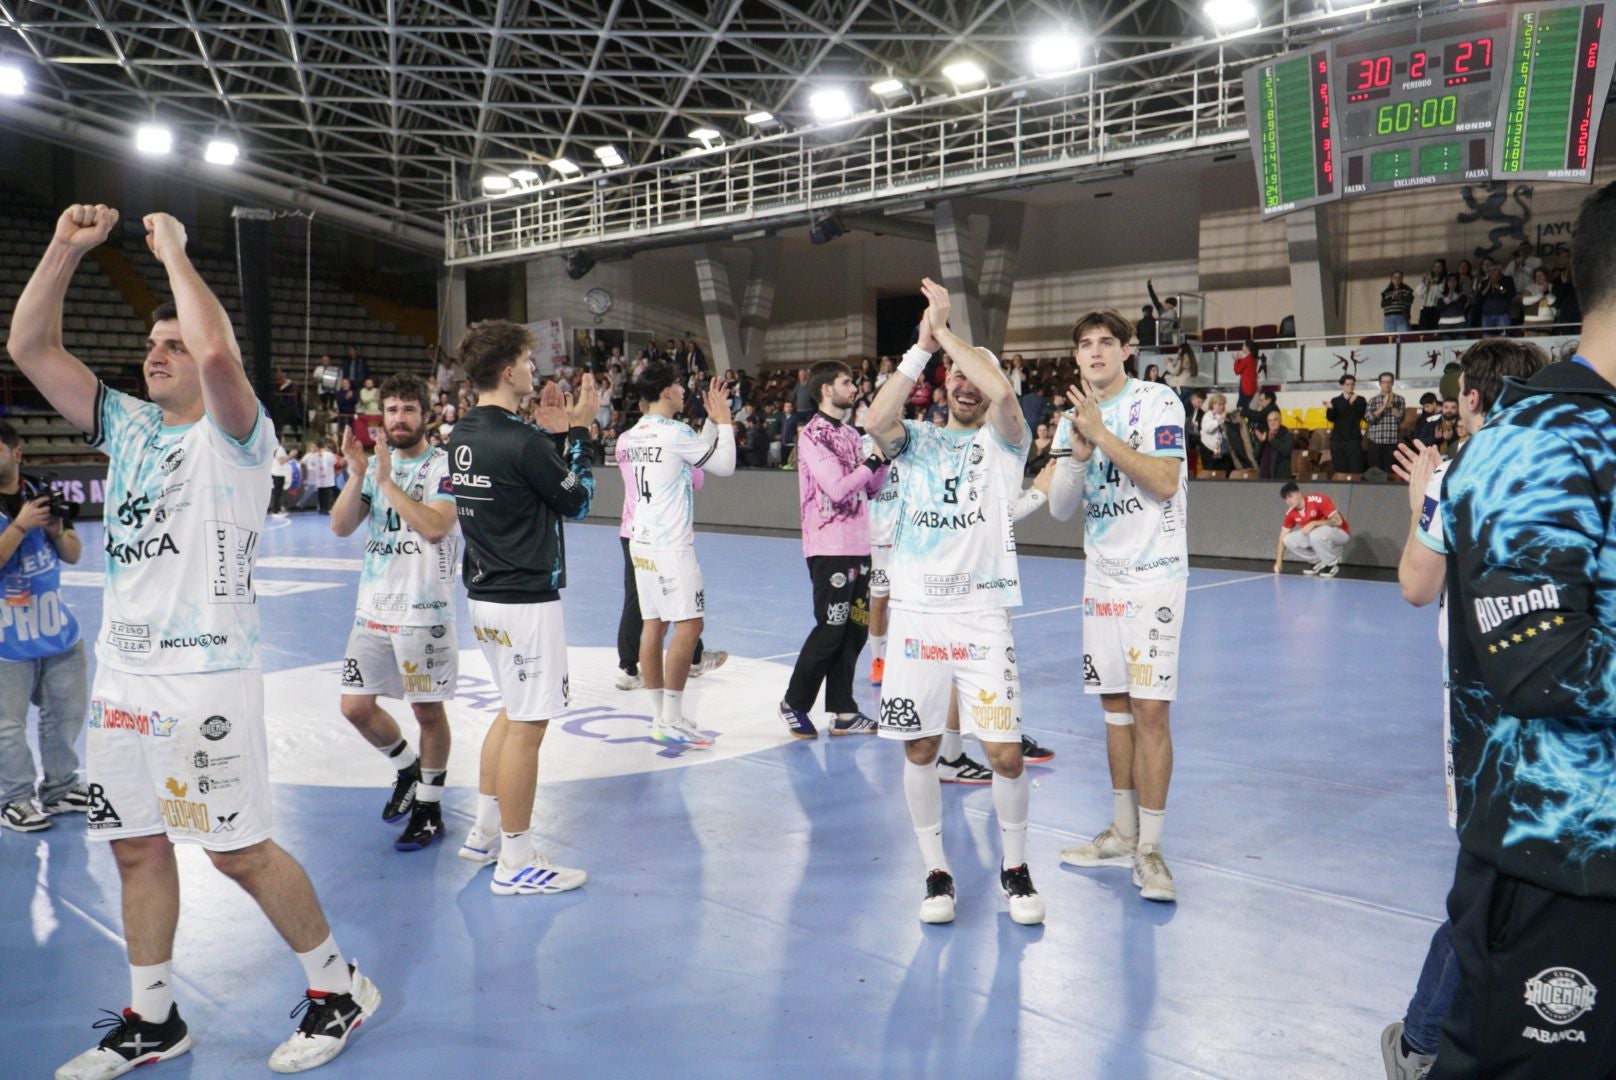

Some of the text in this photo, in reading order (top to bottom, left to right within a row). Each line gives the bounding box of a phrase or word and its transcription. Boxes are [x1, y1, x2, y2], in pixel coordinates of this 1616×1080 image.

[1524, 37, 1532, 49] 3
[1455, 38, 1492, 73] 27
[1411, 52, 1426, 78] 2
[1521, 63, 1528, 73] 6
[1357, 56, 1391, 89] 30
[1402, 79, 1432, 90] PERIODO
[1518, 86, 1526, 98] 8
[1377, 95, 1457, 135] 60:00
[1509, 112, 1523, 123] 10
[1455, 121, 1492, 131] MONDO
[1507, 124, 1522, 135] 13
[1506, 136, 1521, 147] 15
[1505, 148, 1520, 160] 18
[1503, 161, 1519, 172] 19
[1465, 168, 1489, 179] FALTAS
[1394, 175, 1437, 187] EXCLUSIONES
[1344, 184, 1367, 193] FALTAS
[1264, 202, 1295, 214] MONDO
[451, 472, 492, 488] EXUS
[880, 697, 915, 713] MOR
[879, 711, 921, 727] VEGA
